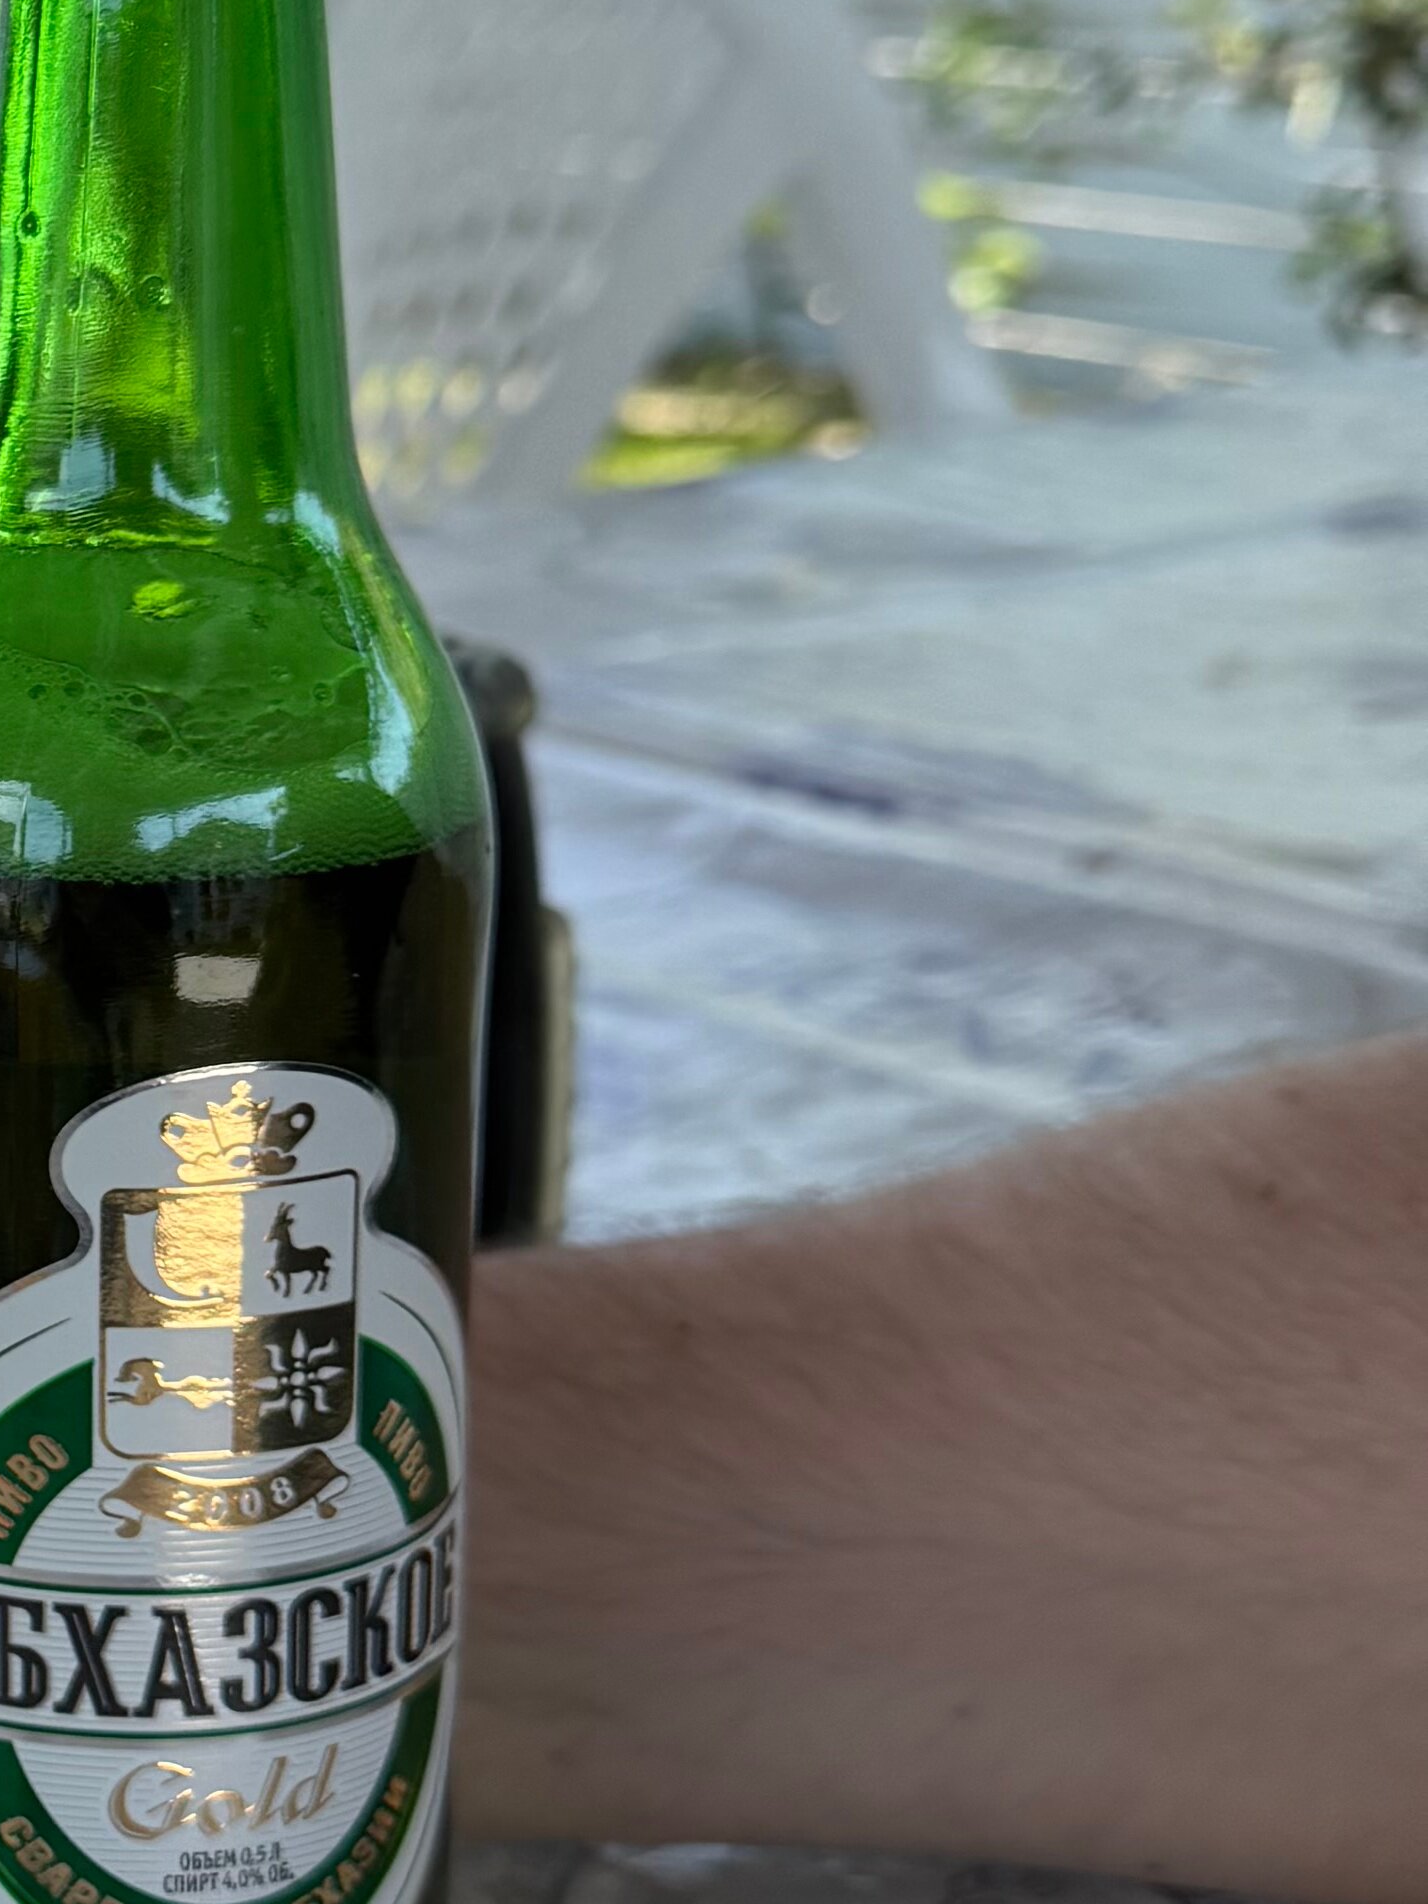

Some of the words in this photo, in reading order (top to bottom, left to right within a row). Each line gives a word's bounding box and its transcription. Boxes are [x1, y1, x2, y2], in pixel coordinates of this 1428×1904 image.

[373, 1399, 433, 1501] ПИВО
[107, 1743, 339, 1840] Gold
[162, 1871, 218, 1893] СПИРТ
[179, 1848, 237, 1871] ОБЪЕМ
